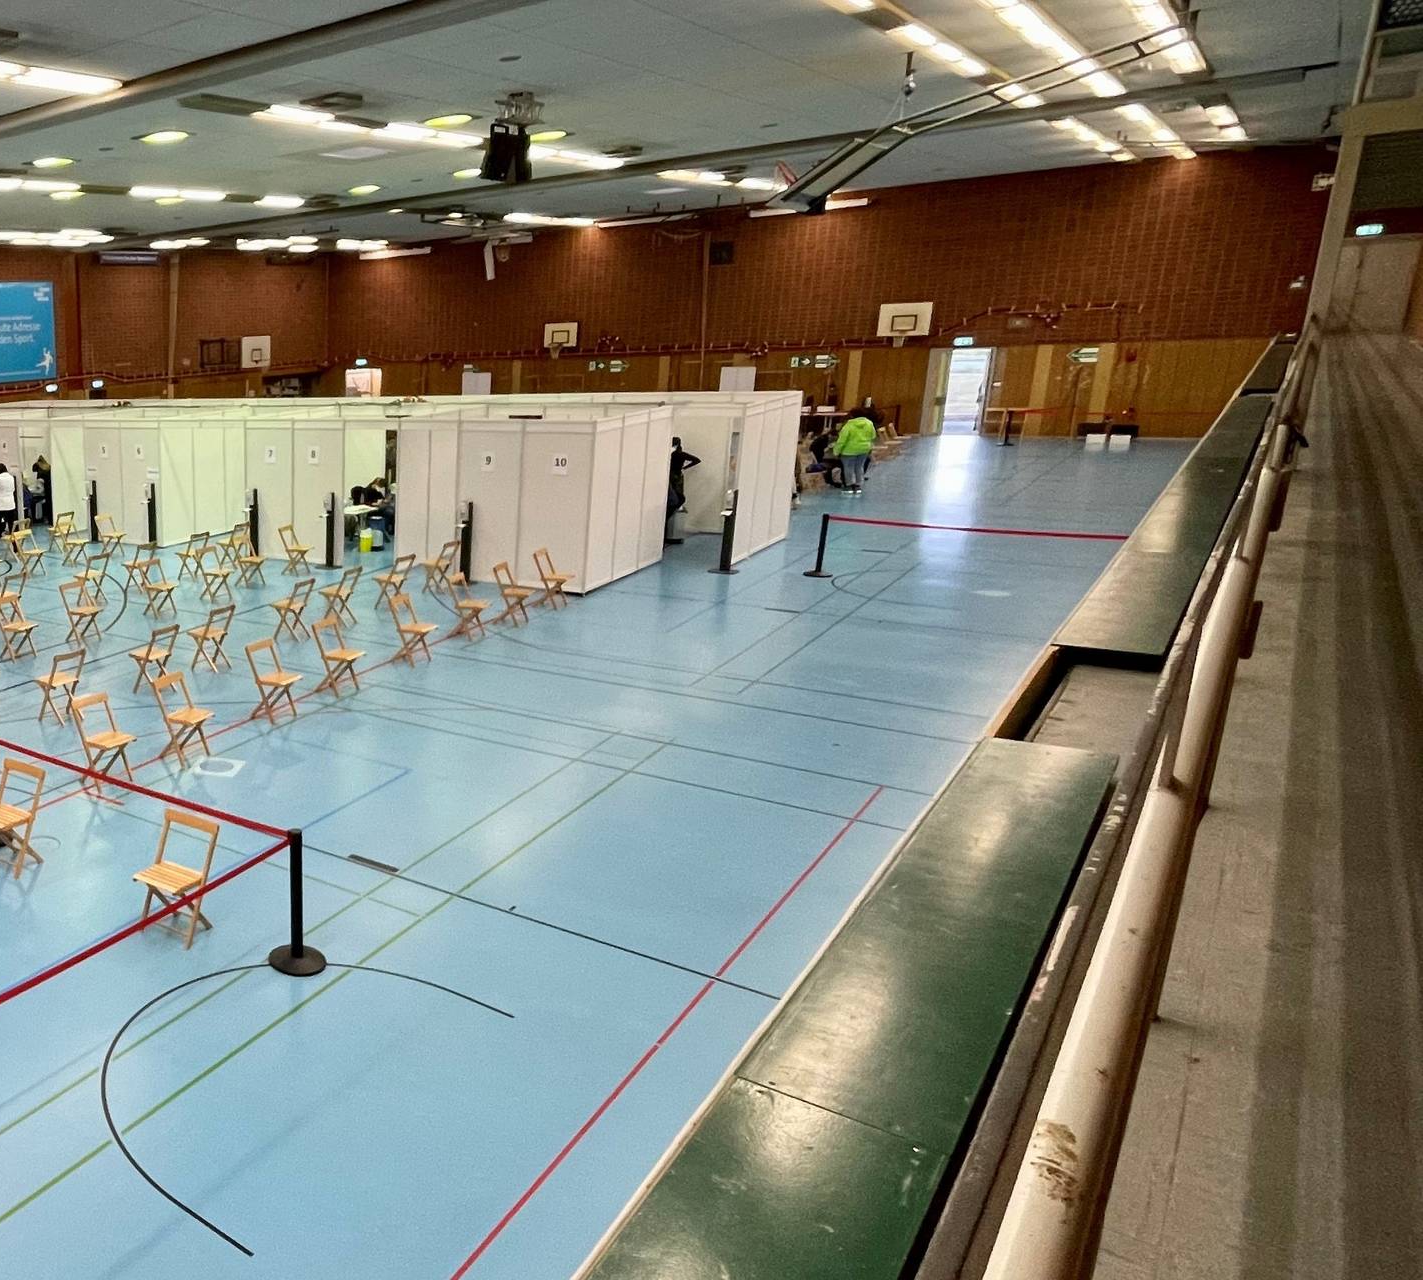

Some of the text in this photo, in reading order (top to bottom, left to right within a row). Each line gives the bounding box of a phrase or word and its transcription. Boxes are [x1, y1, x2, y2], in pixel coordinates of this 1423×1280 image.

[12, 321, 41, 332] Adresse
[485, 456, 492, 466] 9
[555, 458, 567, 467] 10
